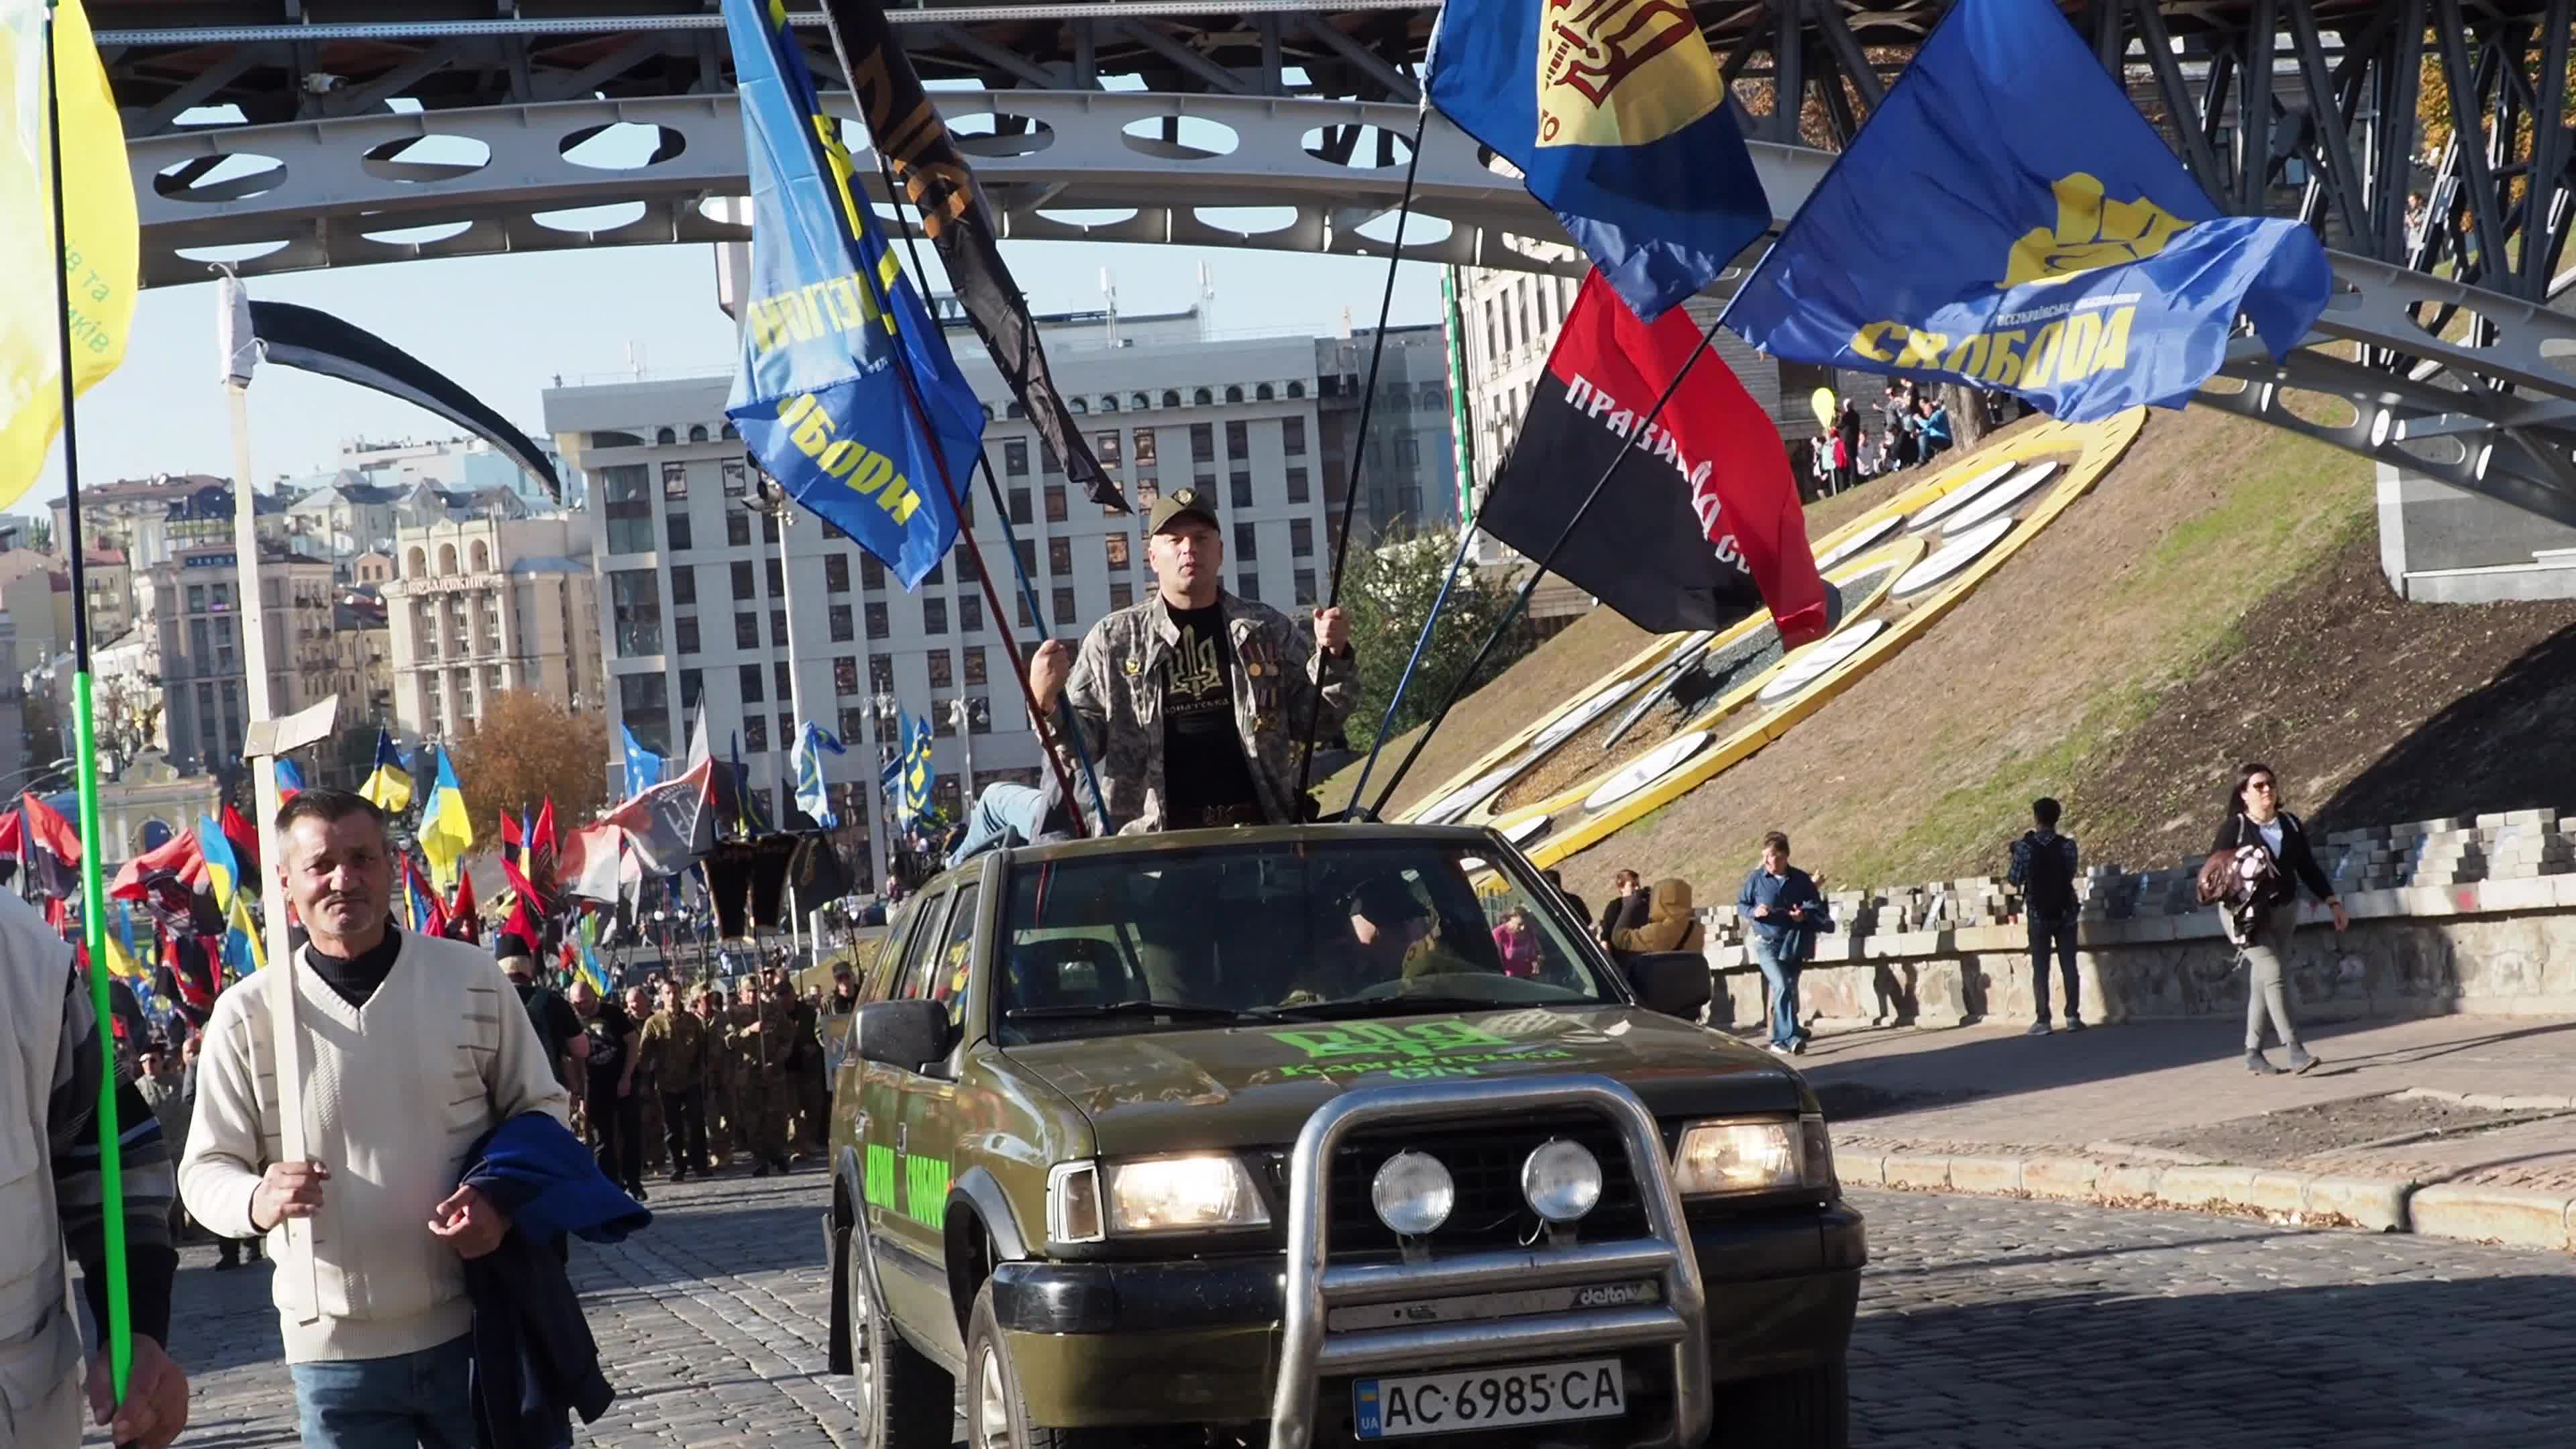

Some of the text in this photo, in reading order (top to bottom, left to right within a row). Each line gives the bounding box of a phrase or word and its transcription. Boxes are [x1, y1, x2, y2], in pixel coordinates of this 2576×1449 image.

[82, 269, 109, 302] та
[1455, 1373, 1551, 1421] 6985
[1361, 1417, 1379, 1431] UA
